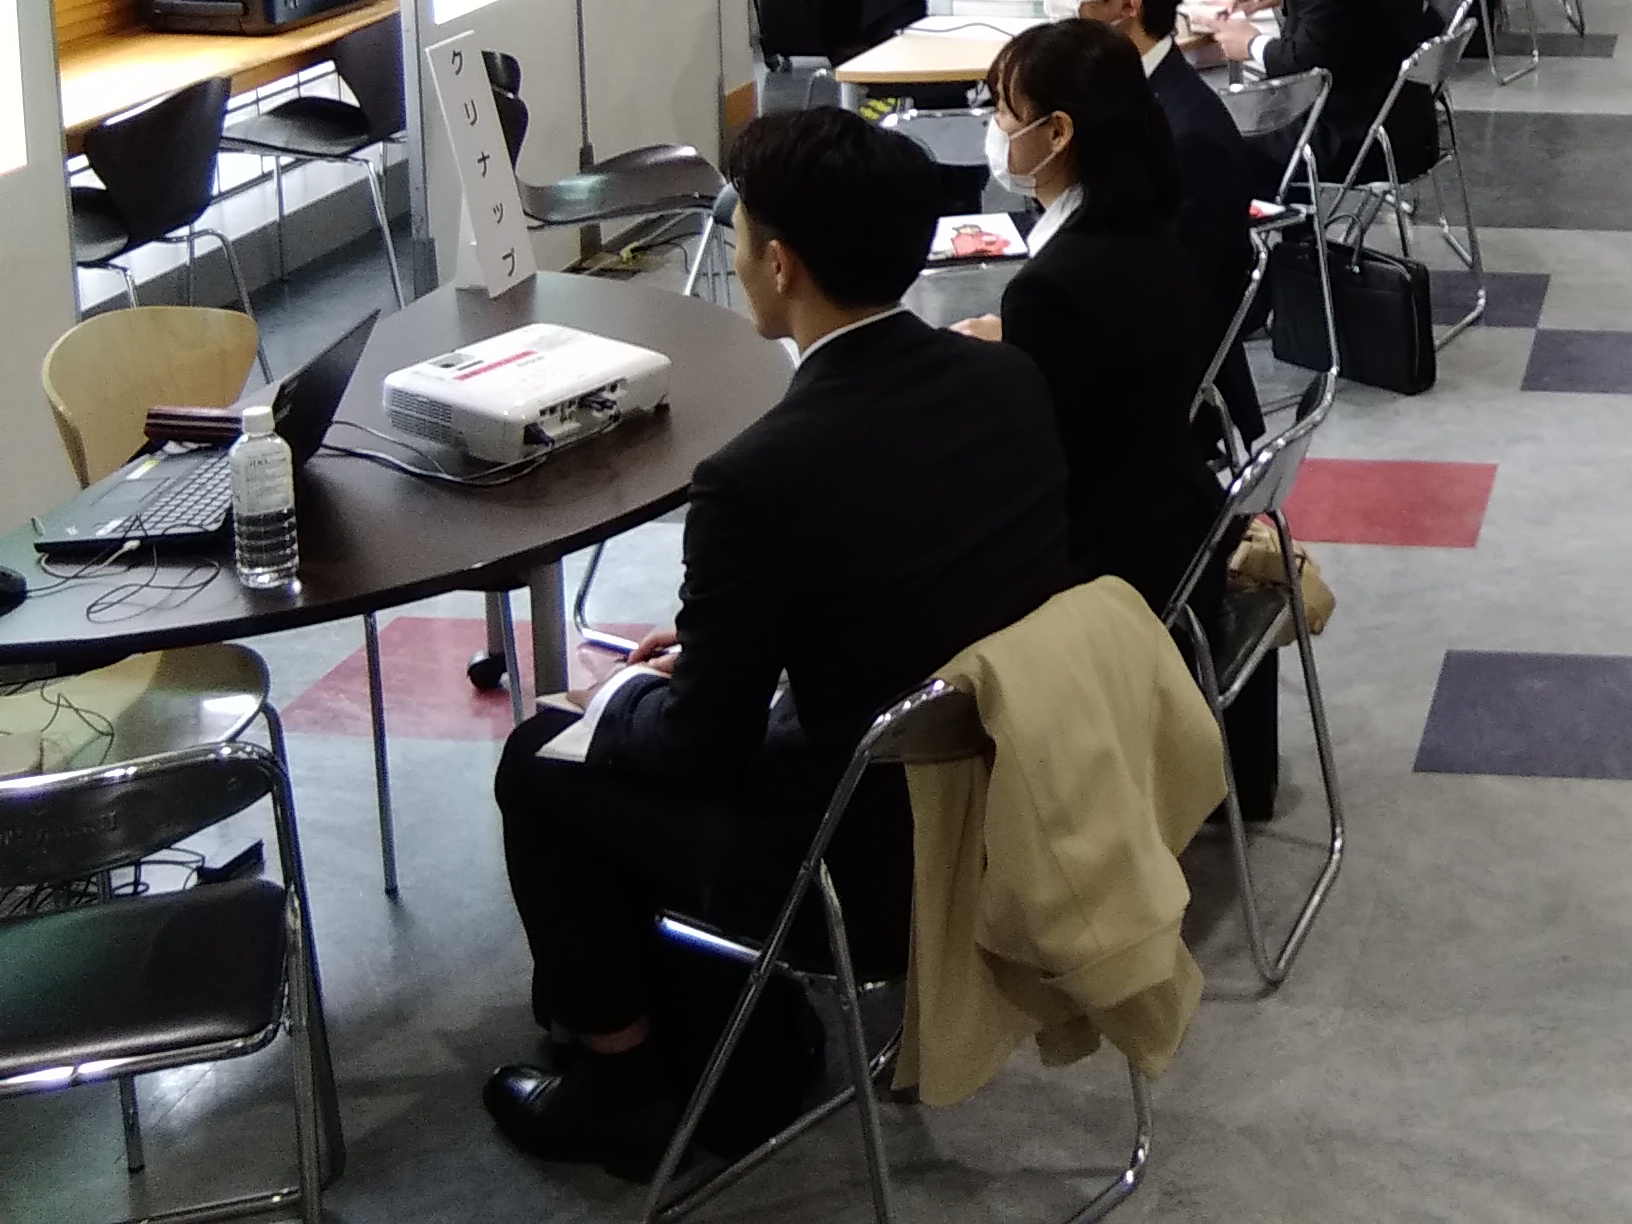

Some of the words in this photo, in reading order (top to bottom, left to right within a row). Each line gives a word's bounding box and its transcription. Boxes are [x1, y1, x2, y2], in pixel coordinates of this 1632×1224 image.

[450, 49, 516, 277] クリナップ
